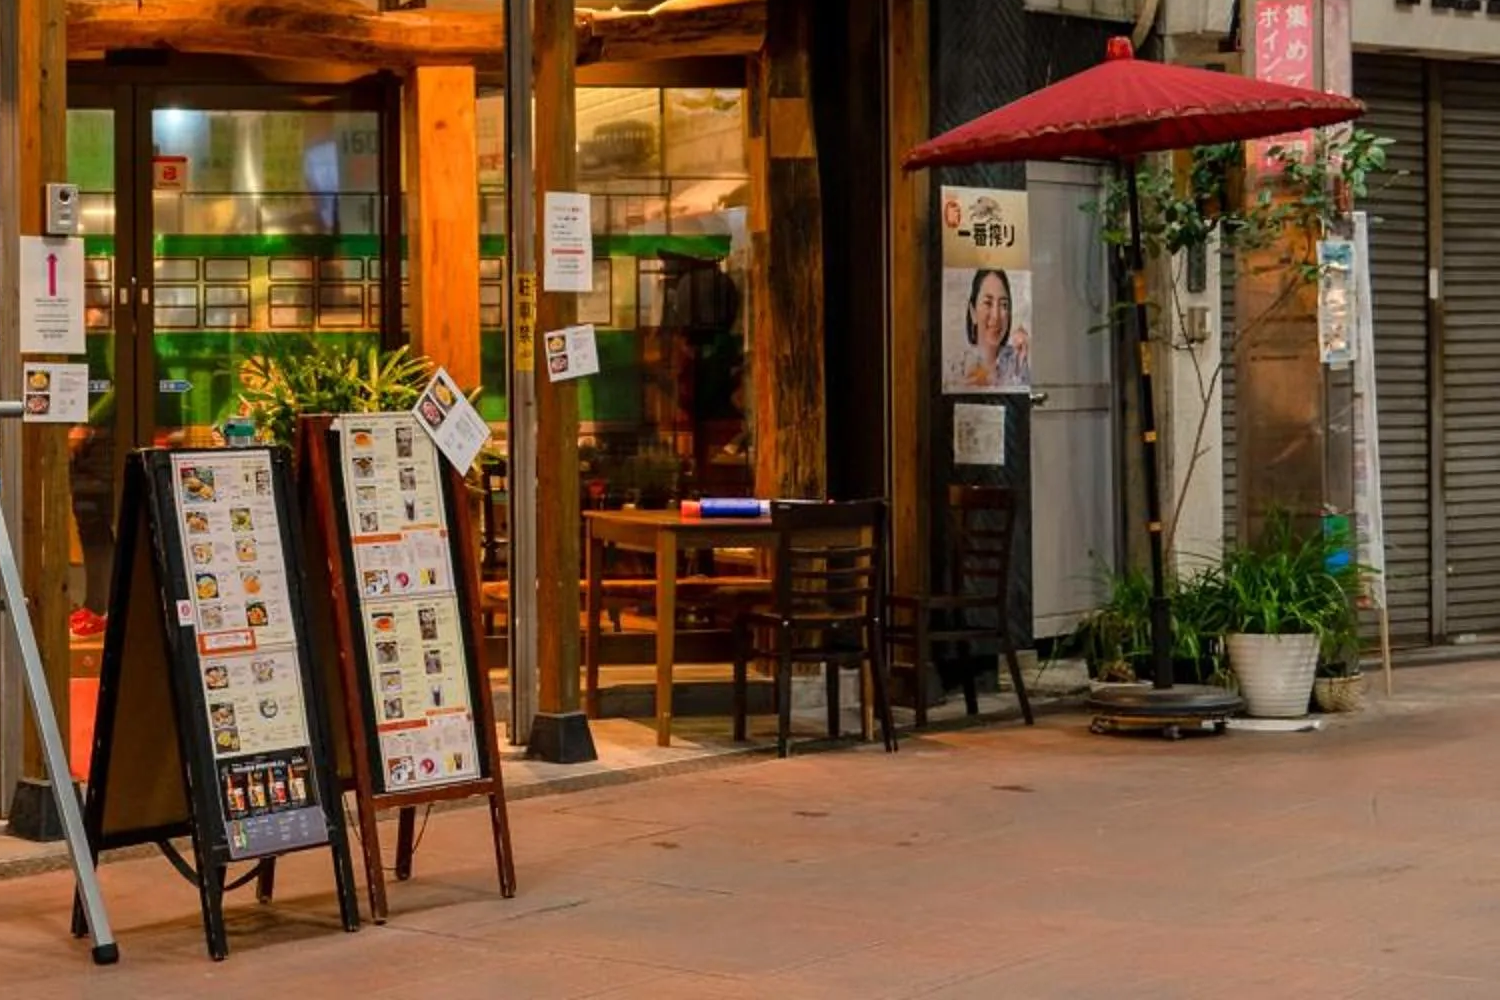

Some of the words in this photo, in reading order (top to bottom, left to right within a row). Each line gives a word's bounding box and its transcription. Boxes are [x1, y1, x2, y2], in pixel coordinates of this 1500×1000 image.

[1258, 6, 1282, 82] ポイン
[957, 222, 1015, 248] 一番搾り
